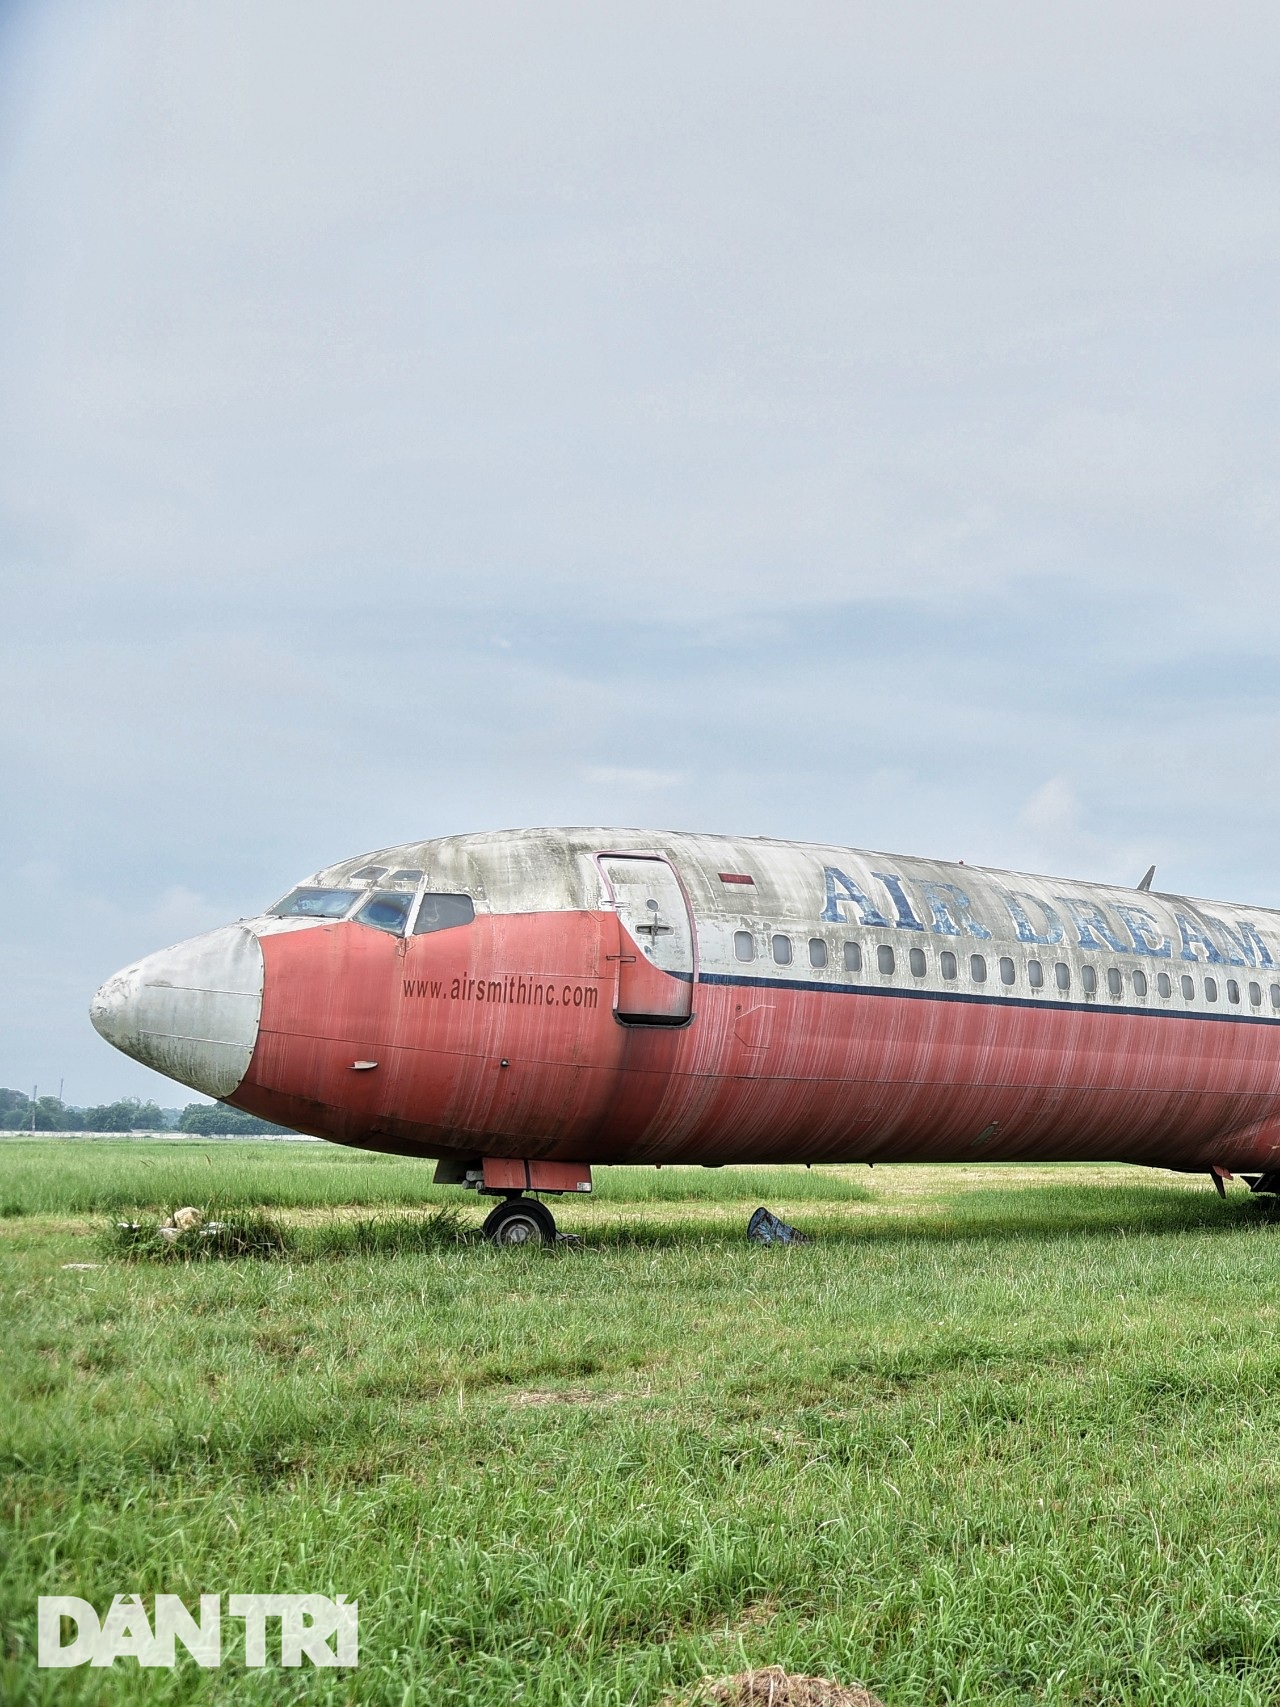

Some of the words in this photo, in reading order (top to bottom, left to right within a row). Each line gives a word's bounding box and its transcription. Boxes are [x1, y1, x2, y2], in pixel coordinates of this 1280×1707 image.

[819, 865, 992, 940] AIR
[1001, 887, 1280, 971] DREAM
[403, 971, 598, 1008] www.airsmithinc.com
